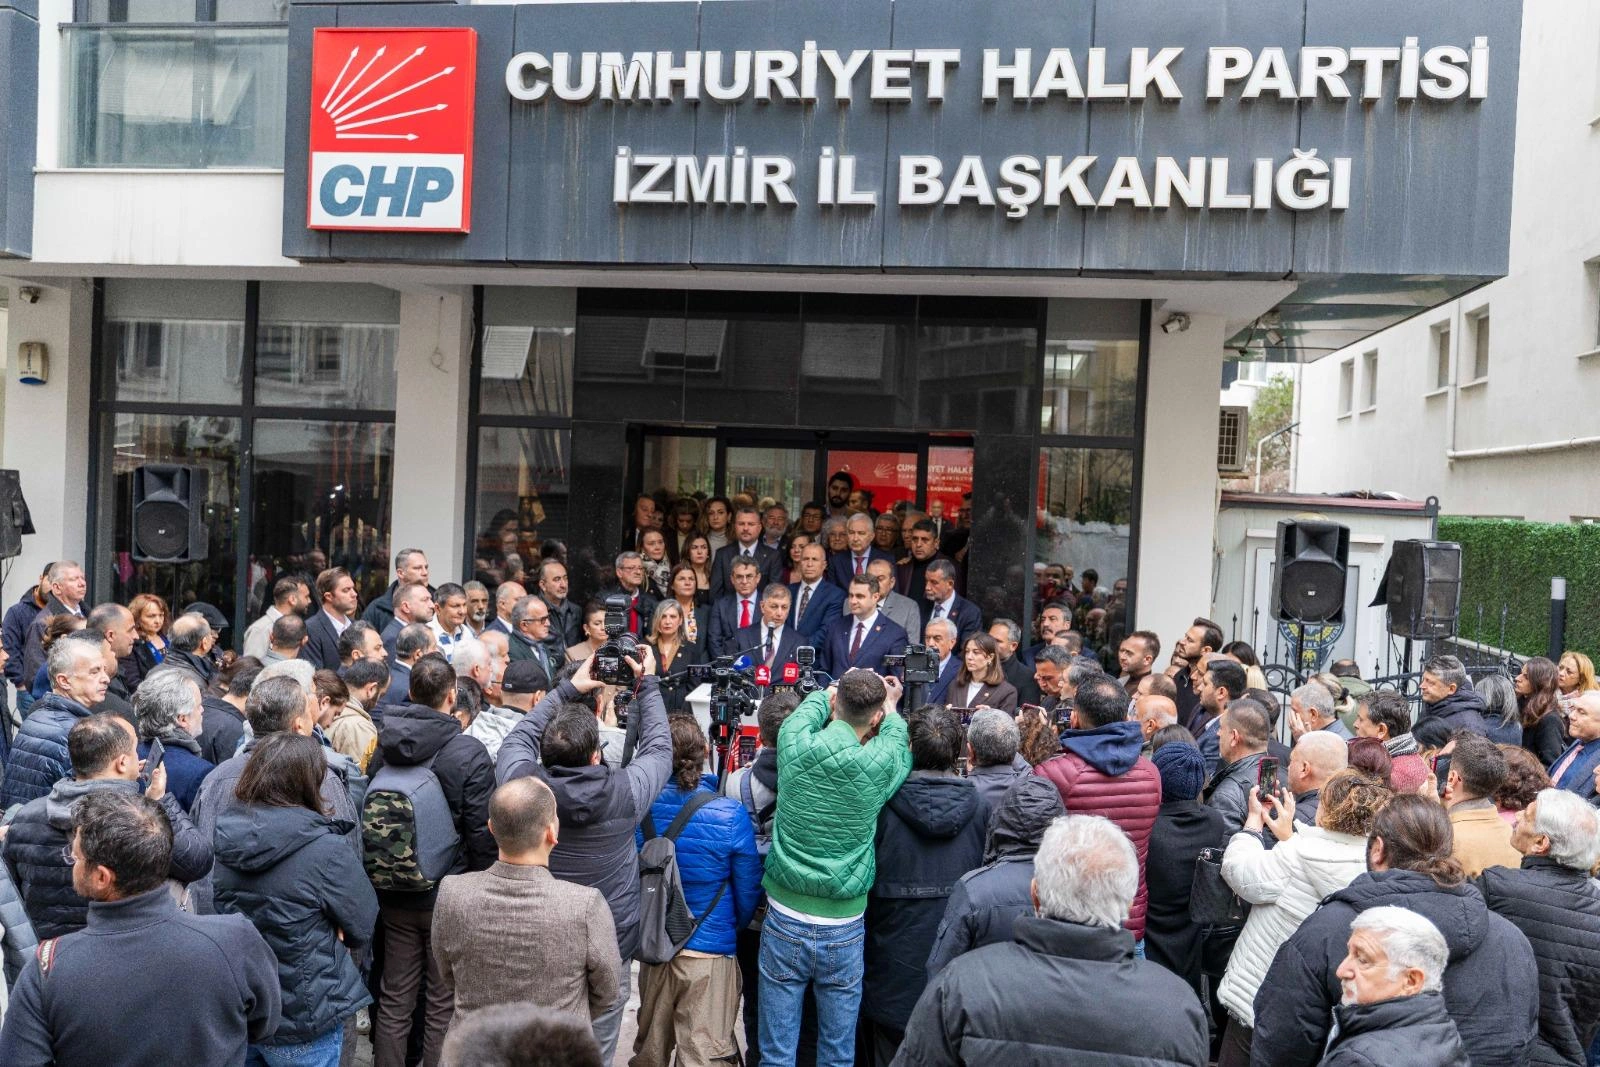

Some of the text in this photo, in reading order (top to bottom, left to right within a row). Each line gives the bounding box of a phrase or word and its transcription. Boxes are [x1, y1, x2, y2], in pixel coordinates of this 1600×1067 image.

[505, 36, 1490, 102] CUMHURİYET HALK PARTİSİ
[319, 164, 455, 217] CHP
[613, 146, 1352, 219] İZMİR İL BAŞKANLIĞI
